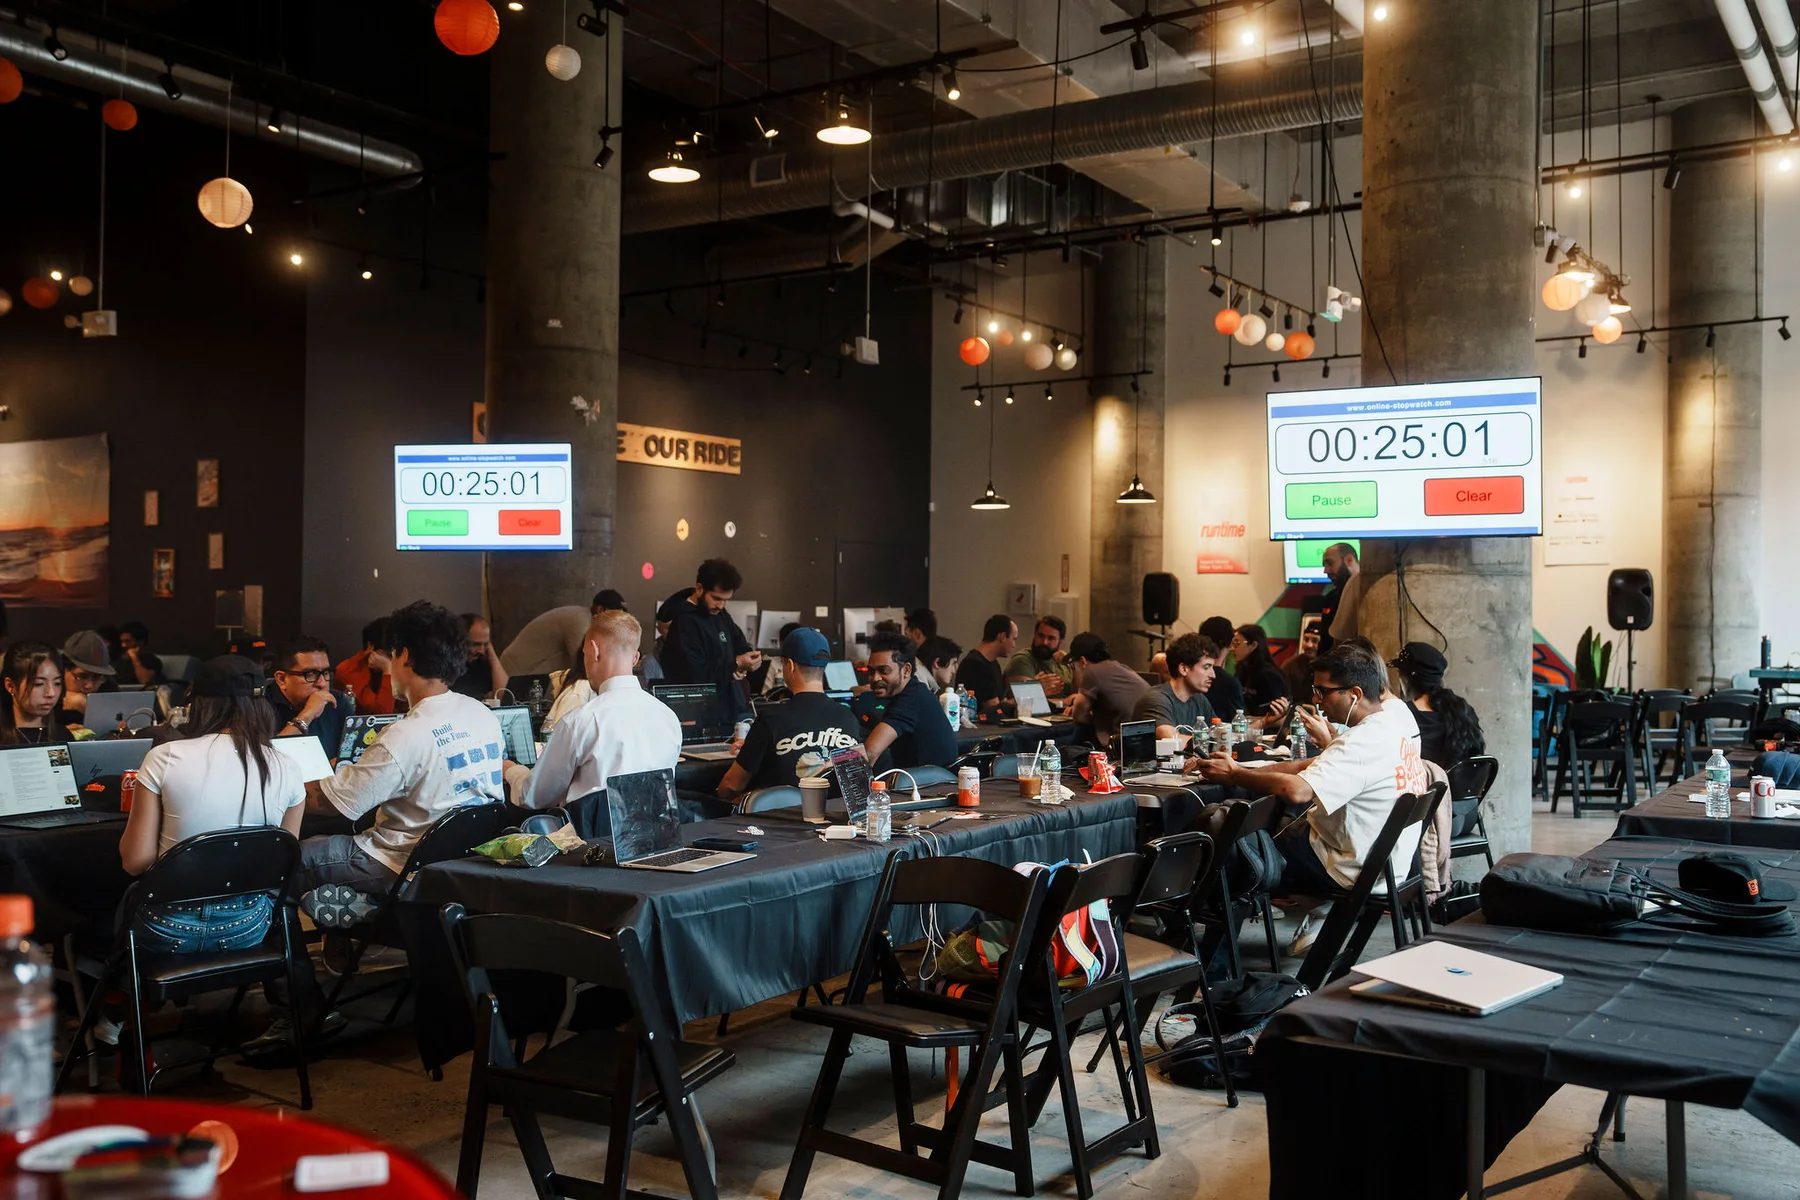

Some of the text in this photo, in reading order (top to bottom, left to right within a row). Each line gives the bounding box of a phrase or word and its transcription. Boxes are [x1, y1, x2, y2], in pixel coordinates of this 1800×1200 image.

[1346, 400, 1452, 412] www.online-stopwatch.com
[1308, 419, 1489, 463] 00:25:01
[644, 434, 689, 461] OUR
[694, 441, 741, 467] RIDE
[422, 471, 540, 497] 00:25:01
[1312, 495, 1352, 507] Pause
[1455, 489, 1493, 502] Clear
[424, 518, 452, 528] Pause
[517, 518, 542, 528] Clear
[1200, 521, 1246, 538] runtime
[432, 723, 453, 738] Build
[436, 737, 450, 748] the
